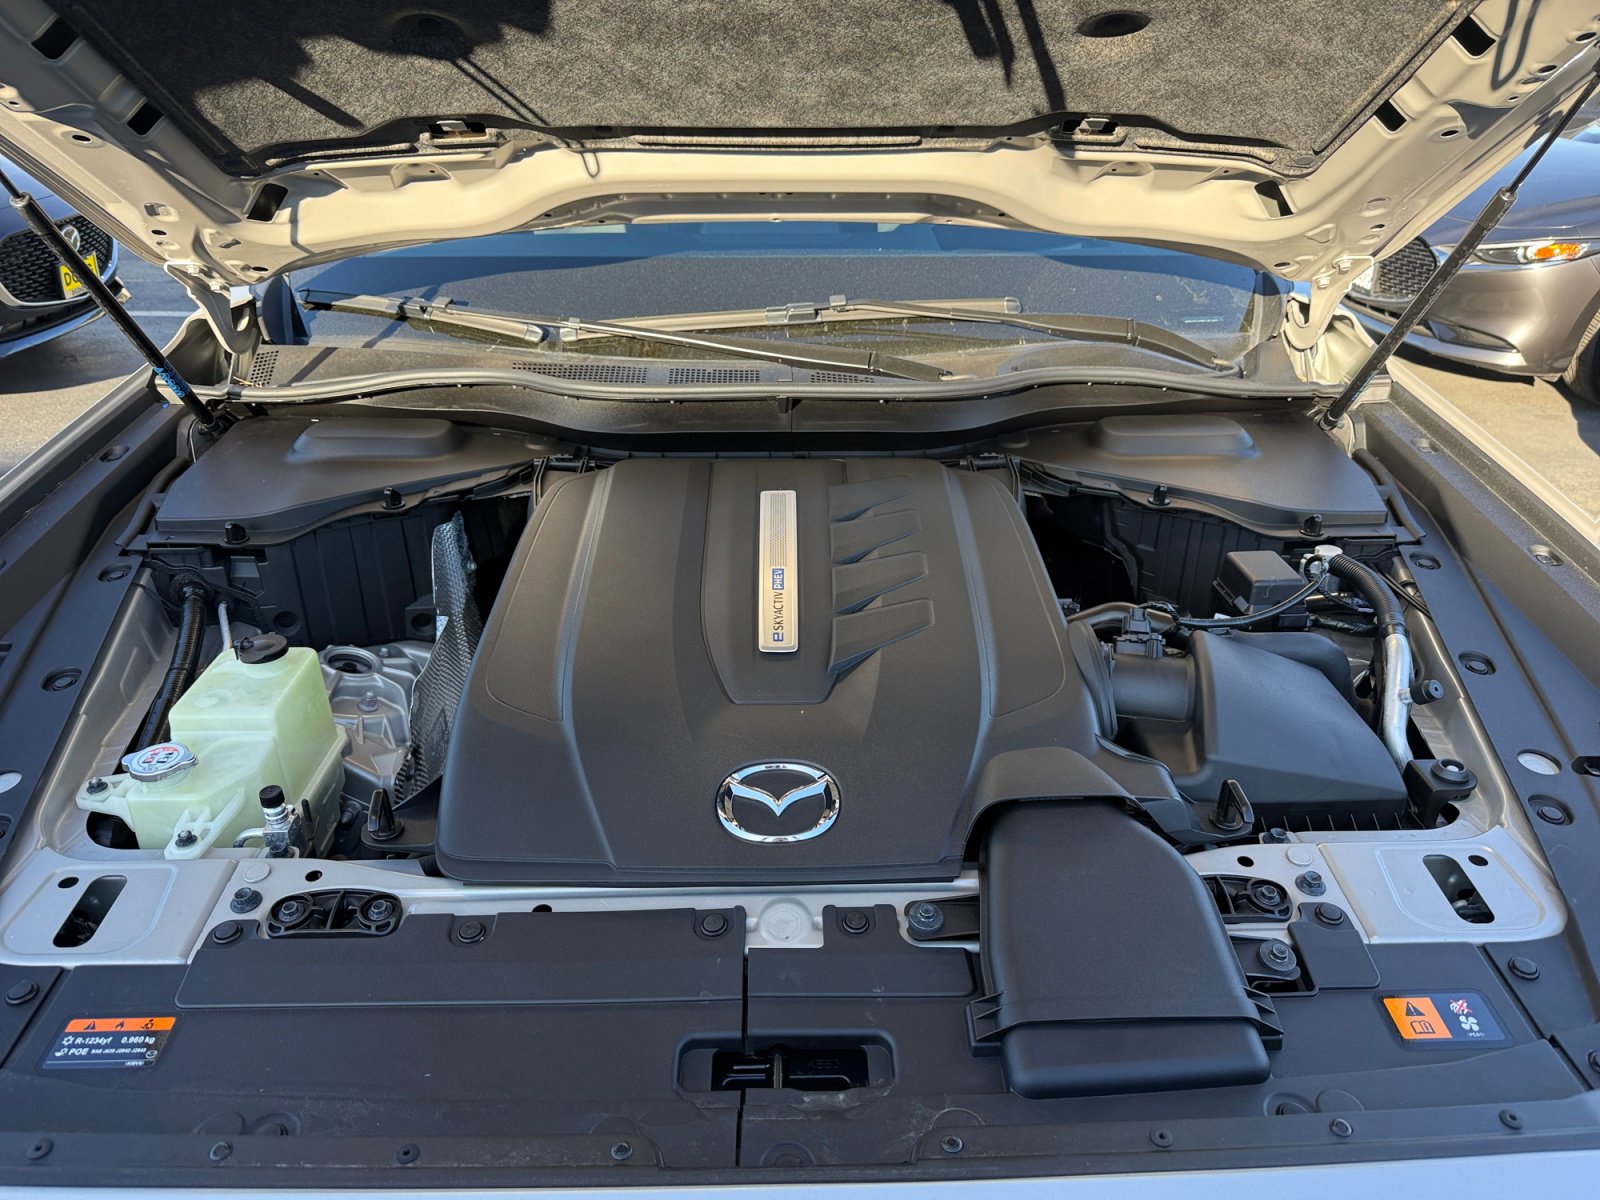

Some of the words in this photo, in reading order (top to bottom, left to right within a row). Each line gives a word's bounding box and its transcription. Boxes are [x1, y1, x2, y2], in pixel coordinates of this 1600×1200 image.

[774, 569, 783, 589] PHEV
[773, 591, 784, 631] SKYACTIV
[74, 1036, 113, 1046] R-1234yf
[121, 1036, 144, 1044] 0.960
[144, 1036, 156, 1045] kg
[68, 1047, 89, 1056] POE
